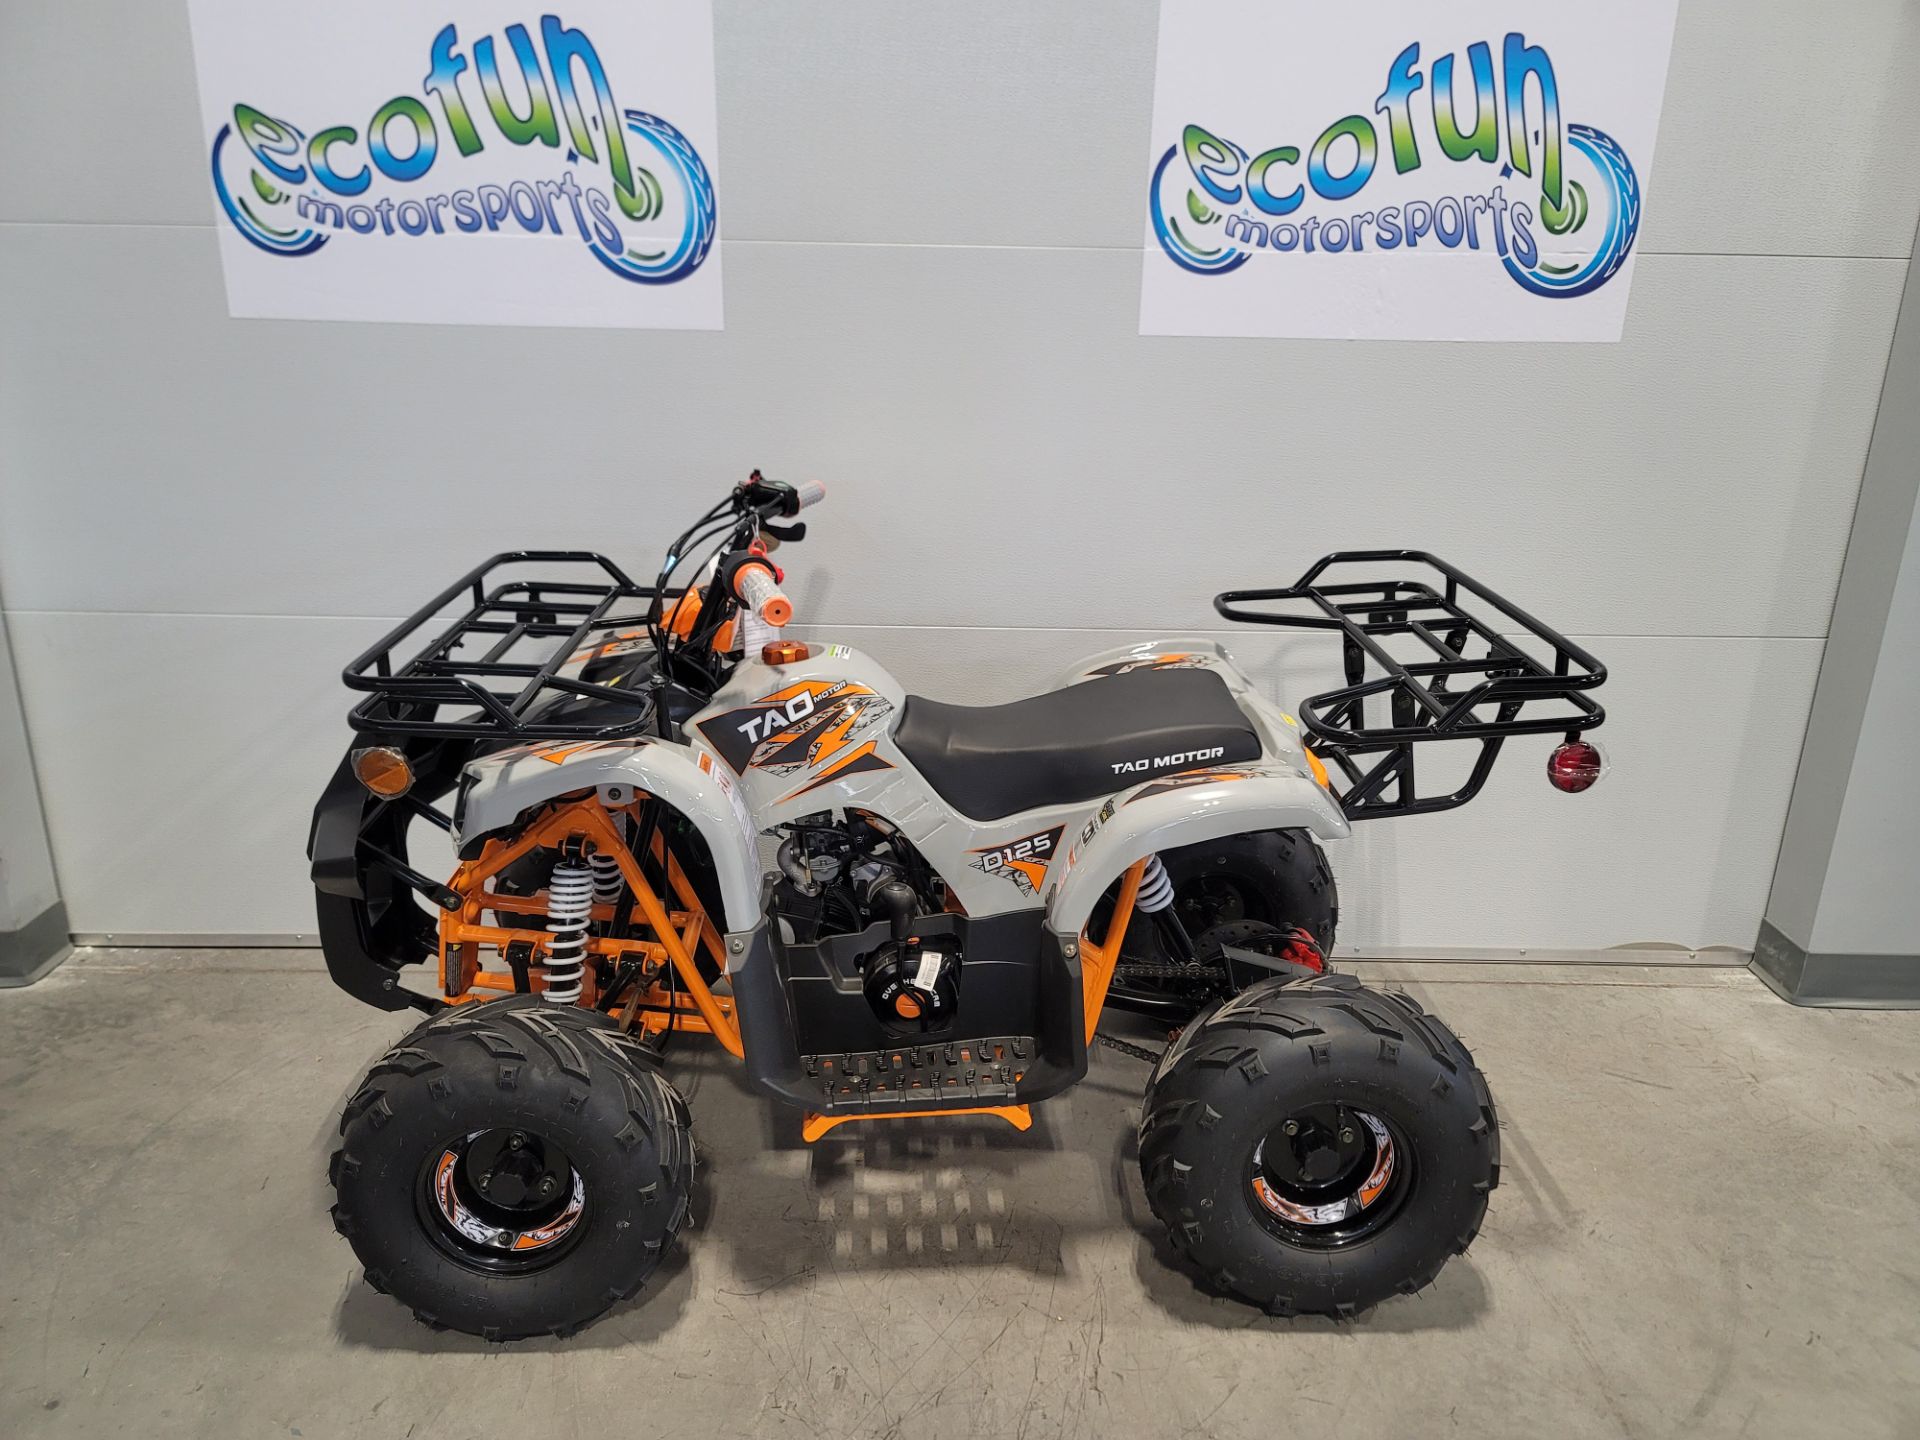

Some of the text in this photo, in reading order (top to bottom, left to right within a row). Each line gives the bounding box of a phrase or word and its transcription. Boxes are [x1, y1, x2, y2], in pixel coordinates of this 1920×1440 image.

[298, 172, 624, 256] motorsports
[1225, 186, 1539, 269] motorsports
[737, 680, 847, 743] TAO MOTOR
[1111, 747, 1224, 774] TAO MOTOR
[982, 833, 1050, 873] D125
[882, 982, 898, 1000] OVE
